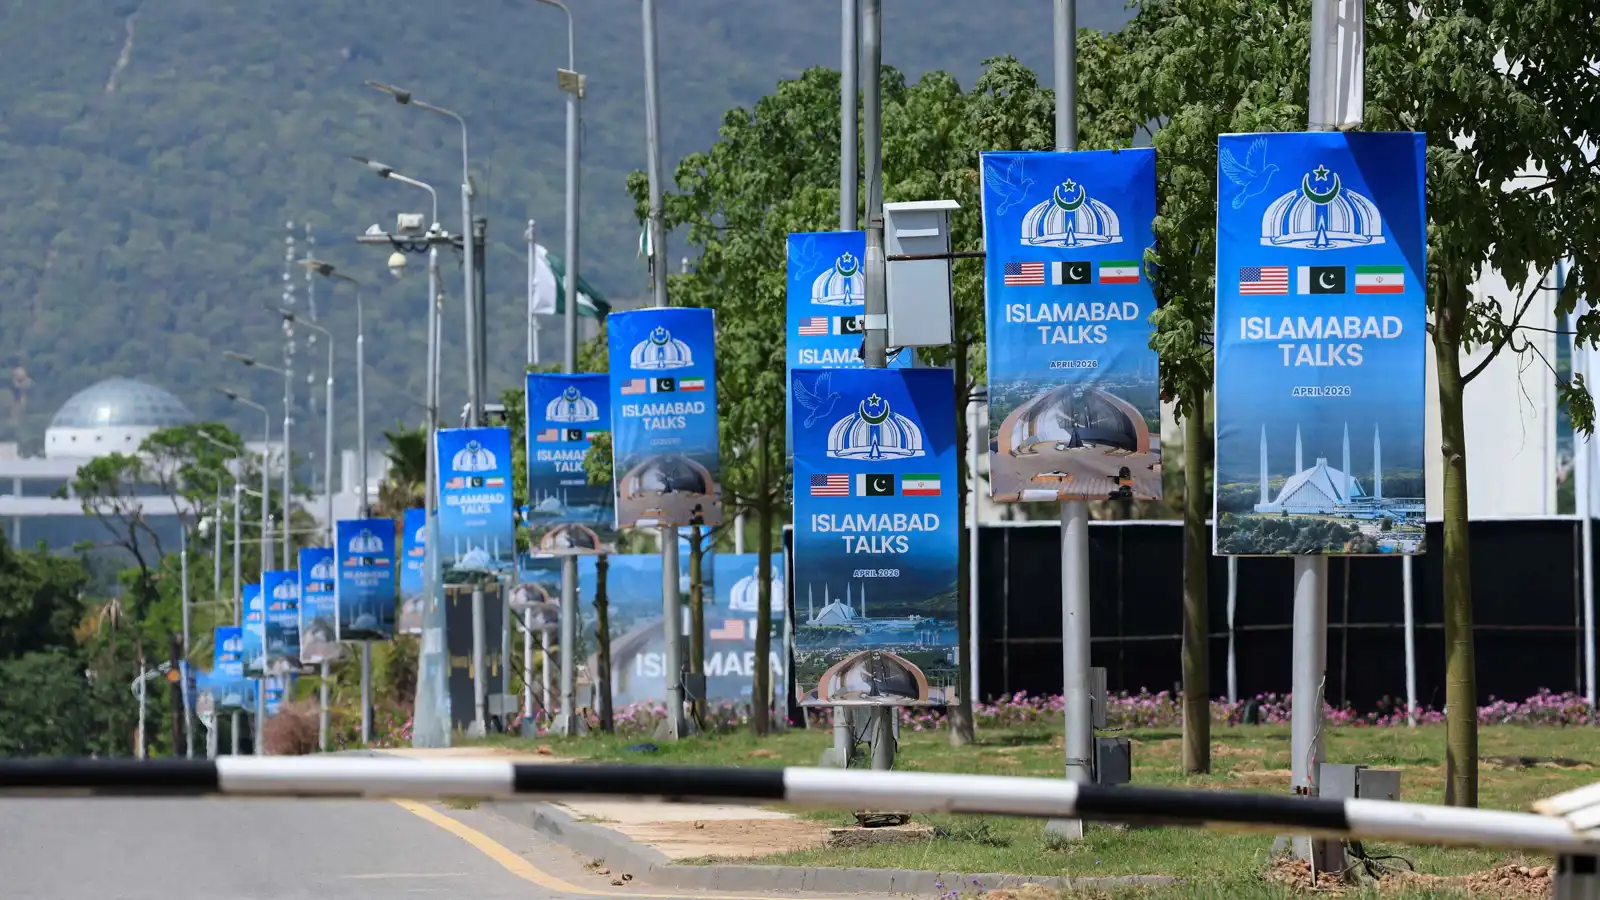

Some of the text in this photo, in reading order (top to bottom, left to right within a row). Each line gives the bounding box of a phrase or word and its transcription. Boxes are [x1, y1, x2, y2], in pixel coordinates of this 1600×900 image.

[1006, 301, 1139, 323] ISLAMABAD
[1037, 325, 1108, 345] TALKS
[1240, 316, 1403, 340] ISLAMABAD
[798, 348, 897, 364] ISLAMA
[1278, 343, 1363, 367] TALKS
[1050, 360, 1098, 370] APRIL 2026
[1292, 386, 1351, 397] APRIL 2026
[622, 401, 705, 417] ISLAMABAD
[642, 416, 686, 430] TALKS
[537, 449, 588, 461] ISLAMA
[553, 461, 586, 473] TALK
[811, 513, 940, 532] ISLAMABAD
[842, 535, 909, 554] TALKS
[853, 569, 900, 577] APRIL 2026
